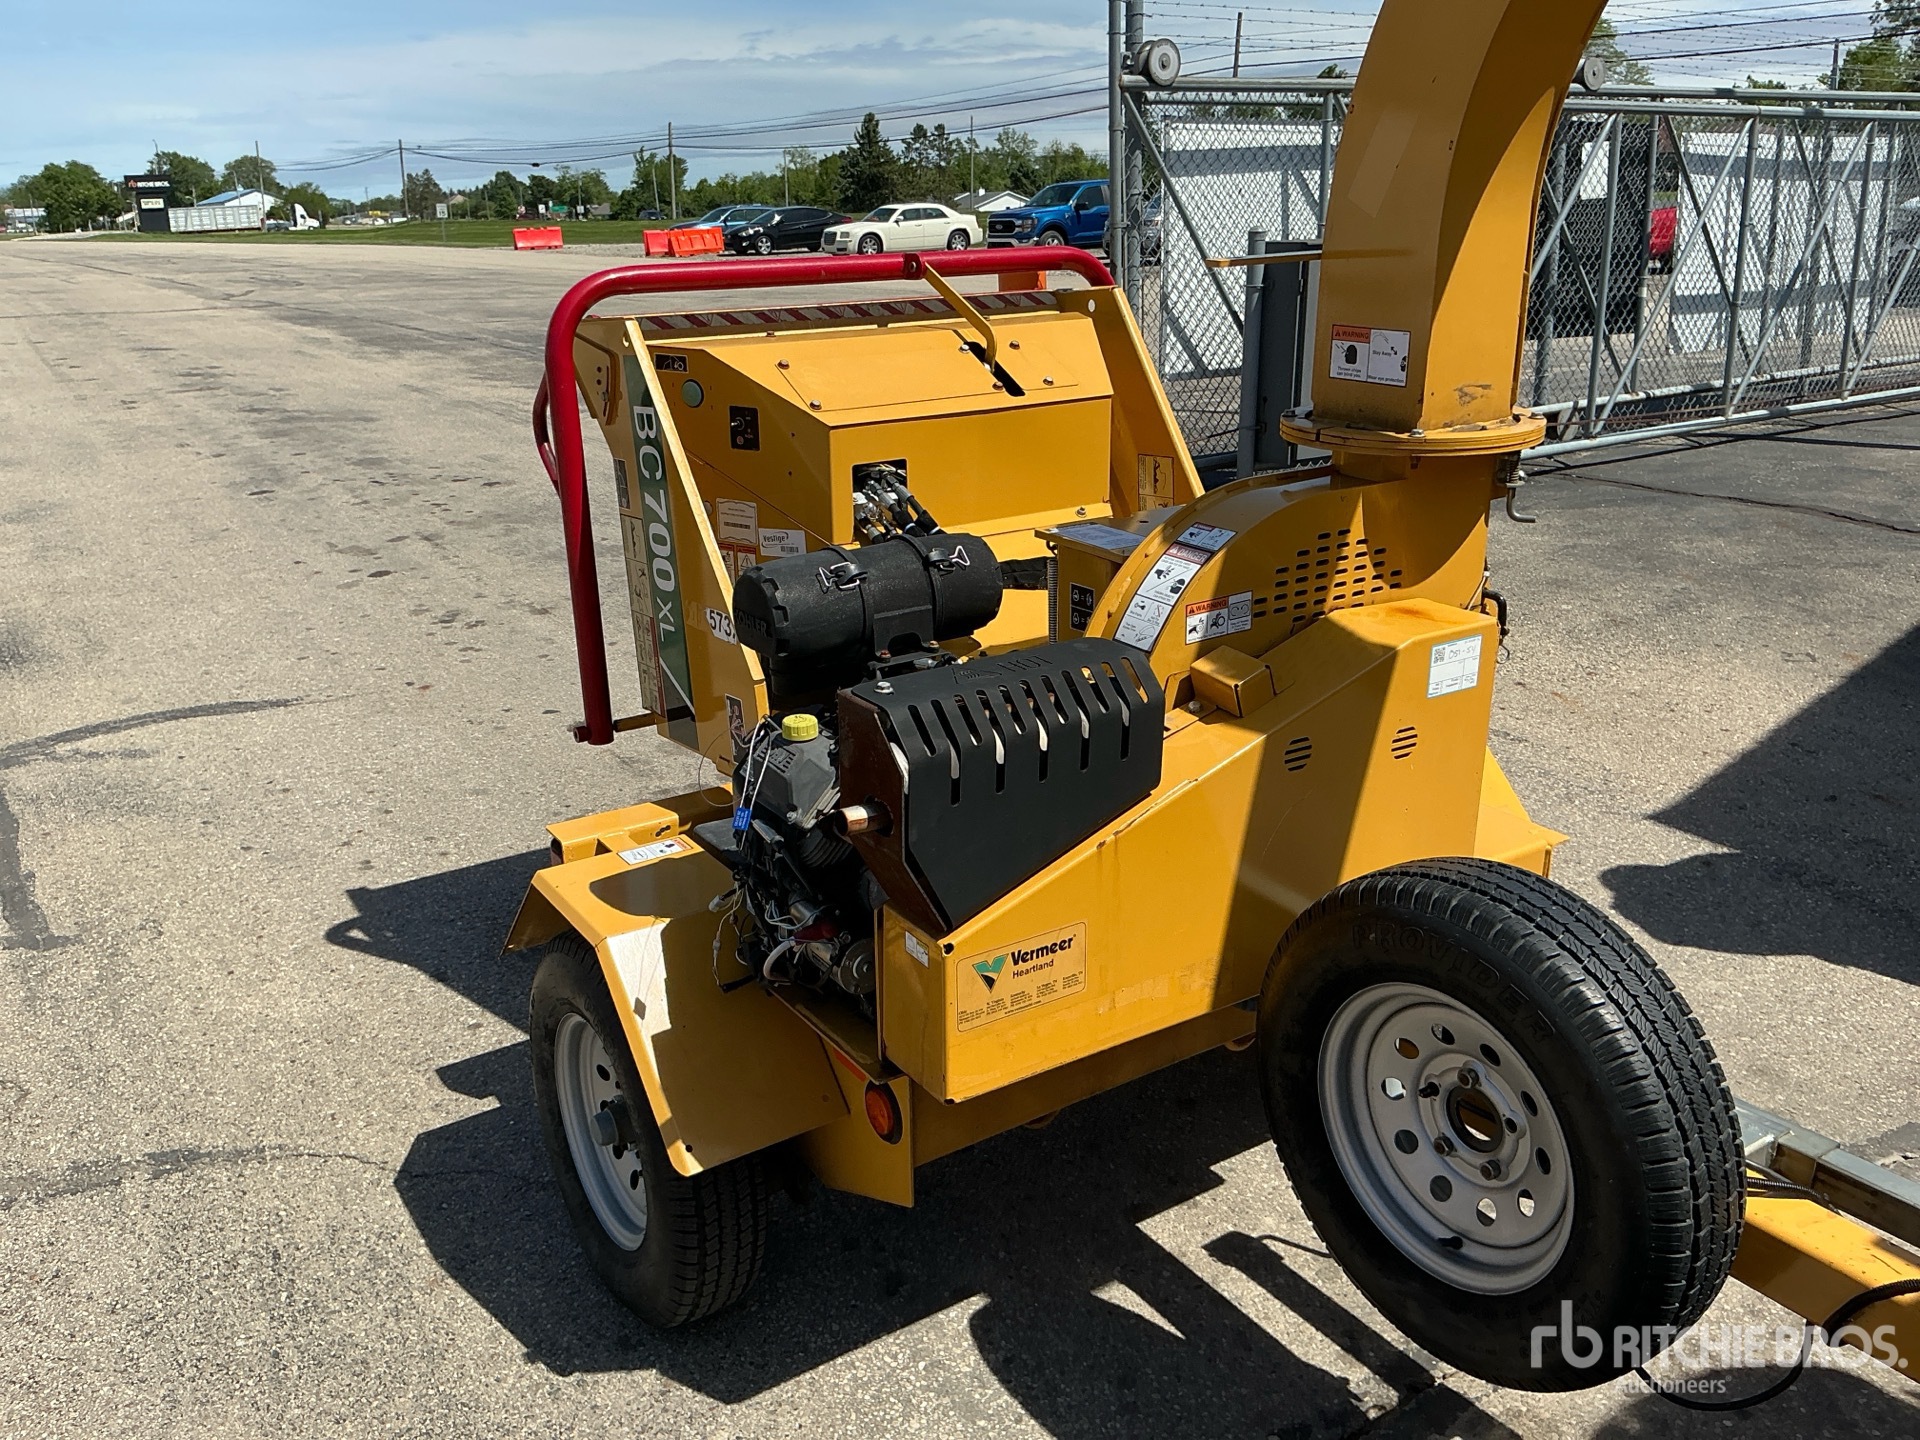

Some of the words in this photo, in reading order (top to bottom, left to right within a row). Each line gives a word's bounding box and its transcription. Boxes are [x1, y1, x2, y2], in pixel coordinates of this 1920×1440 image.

[1342, 331, 1370, 340] WARNING
[762, 534, 786, 544] Vestige
[1179, 548, 1208, 564] DANGER
[1195, 599, 1227, 612] WARNING
[656, 597, 676, 642] XL
[709, 609, 736, 639] 573
[997, 654, 1053, 672] HOT
[1010, 936, 1074, 966] Vermeer
[1012, 958, 1054, 979] Heartland
